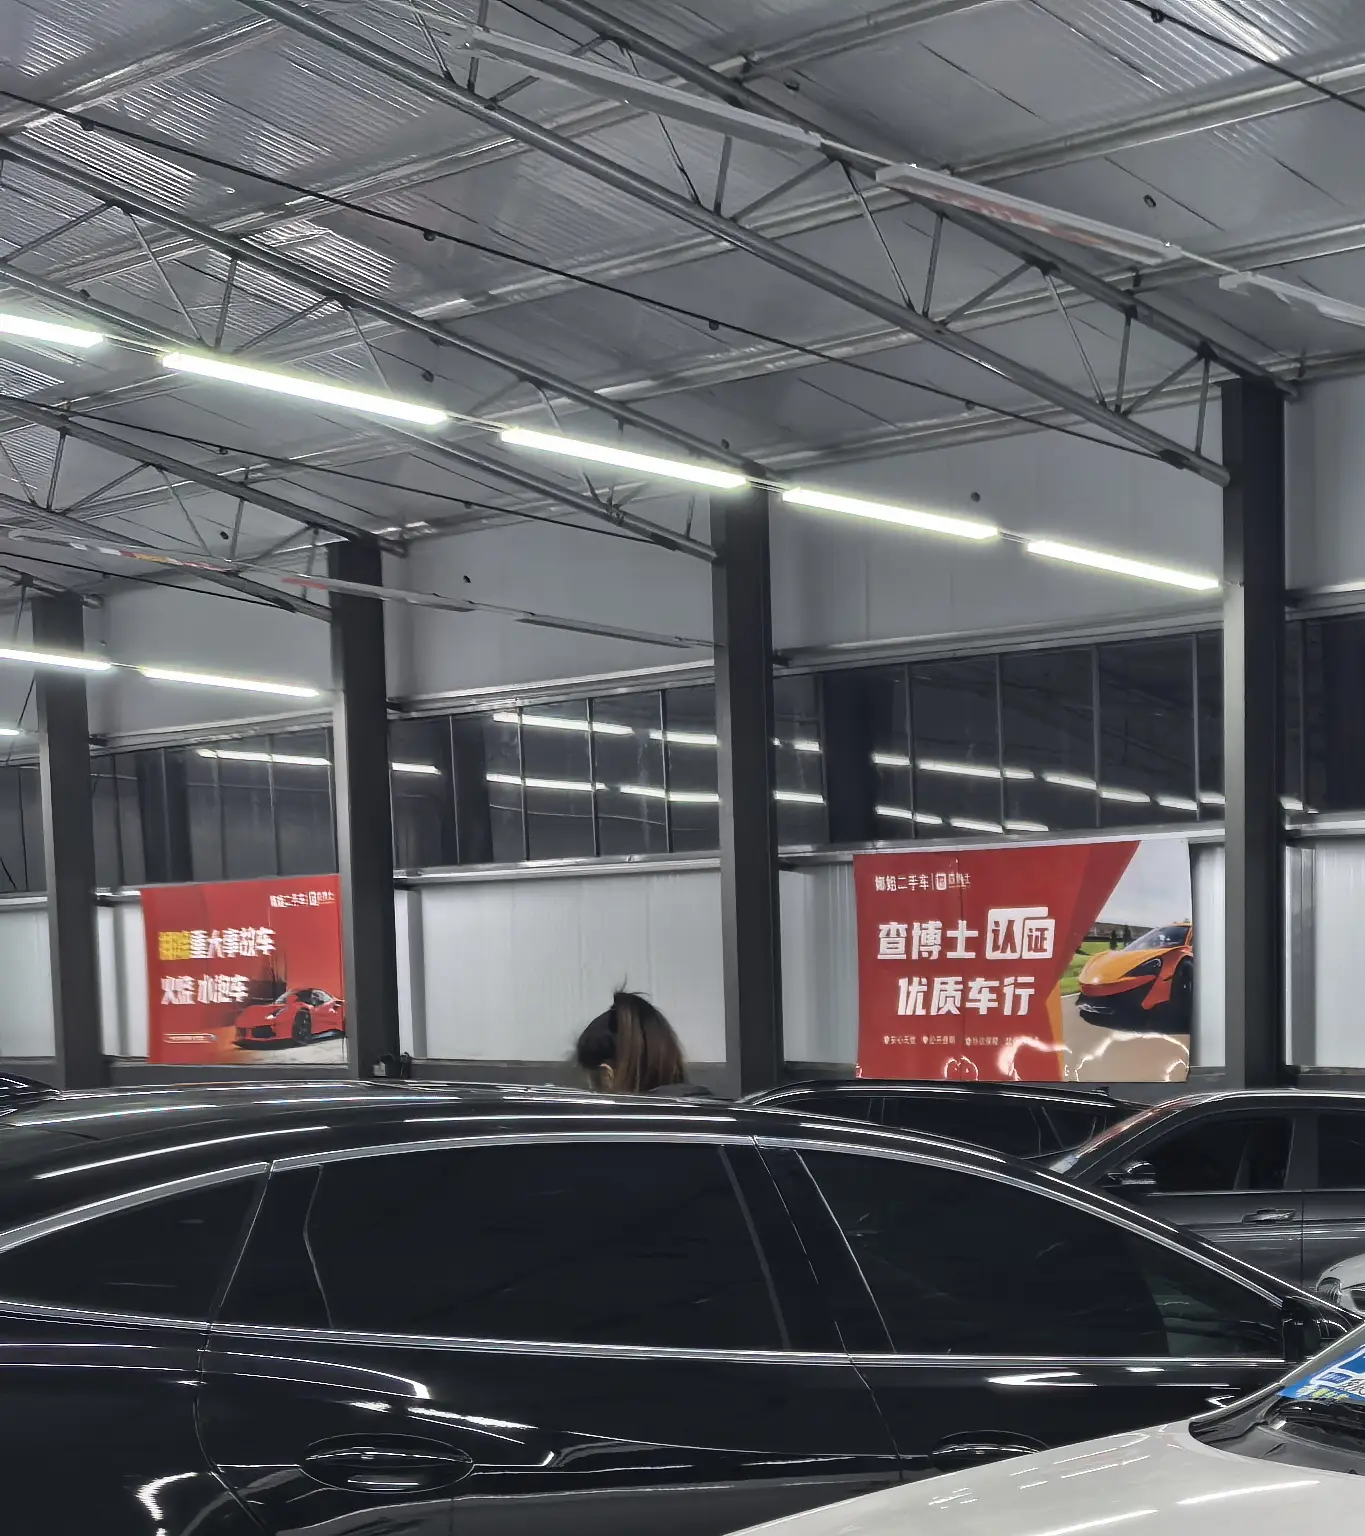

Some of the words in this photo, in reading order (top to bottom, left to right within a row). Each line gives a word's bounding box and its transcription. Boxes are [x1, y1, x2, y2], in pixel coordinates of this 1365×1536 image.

[877, 906, 1055, 960] 查博士认证
[897, 975, 1036, 1016] 优质车行
